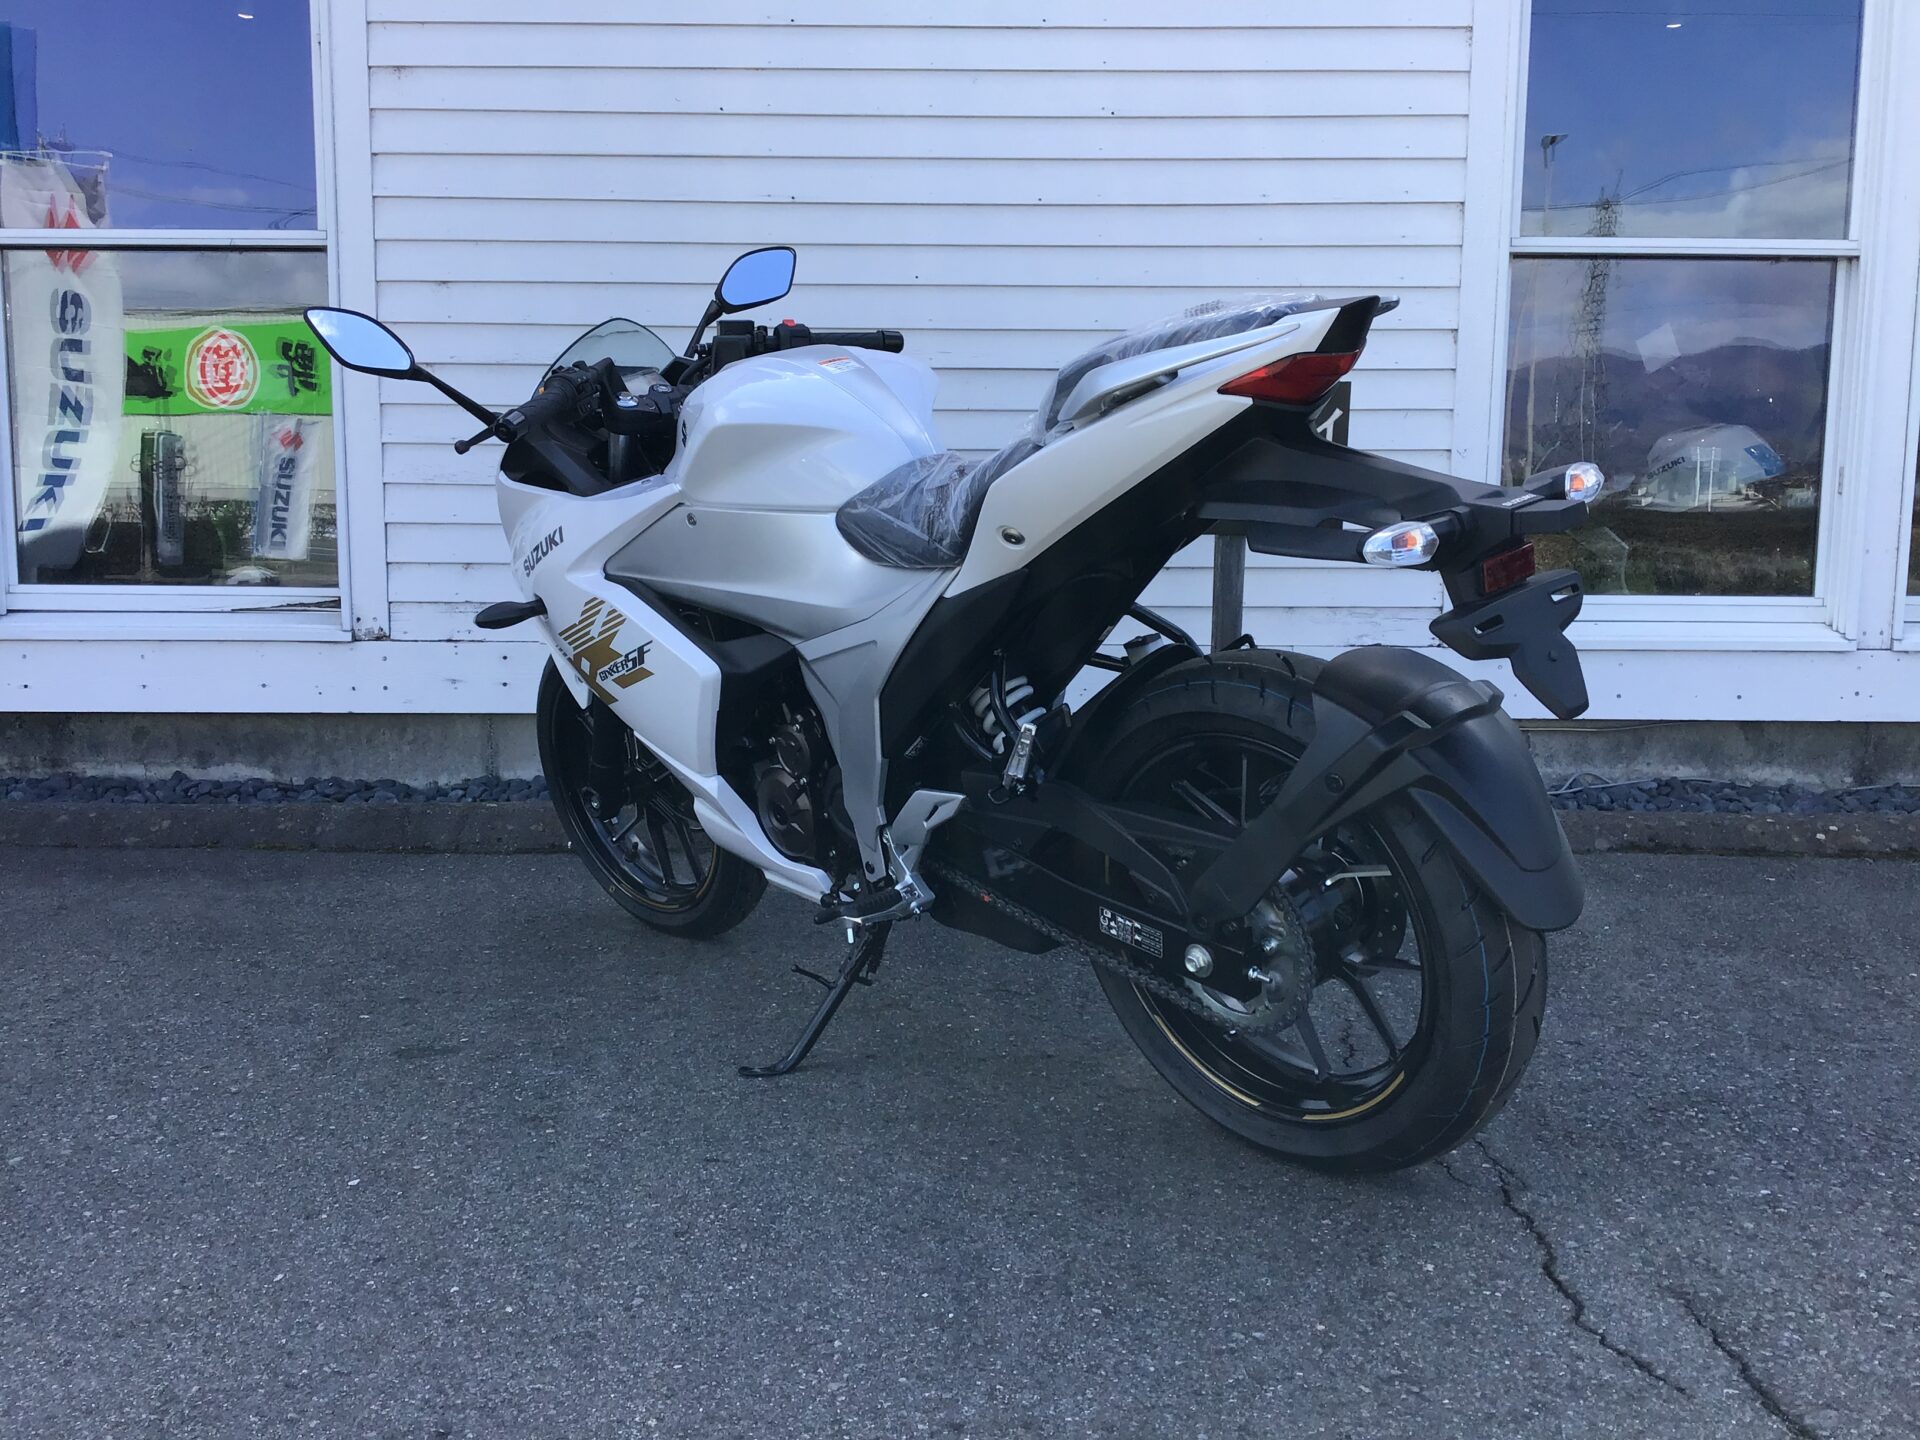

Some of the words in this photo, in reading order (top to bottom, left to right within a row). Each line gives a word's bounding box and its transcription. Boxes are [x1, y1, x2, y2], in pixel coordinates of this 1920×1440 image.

[17, 288, 94, 531] SUZUKI
[269, 455, 298, 551] SUZUKI
[1646, 456, 1686, 480] SUZUKI
[523, 525, 564, 578] SUZUKI
